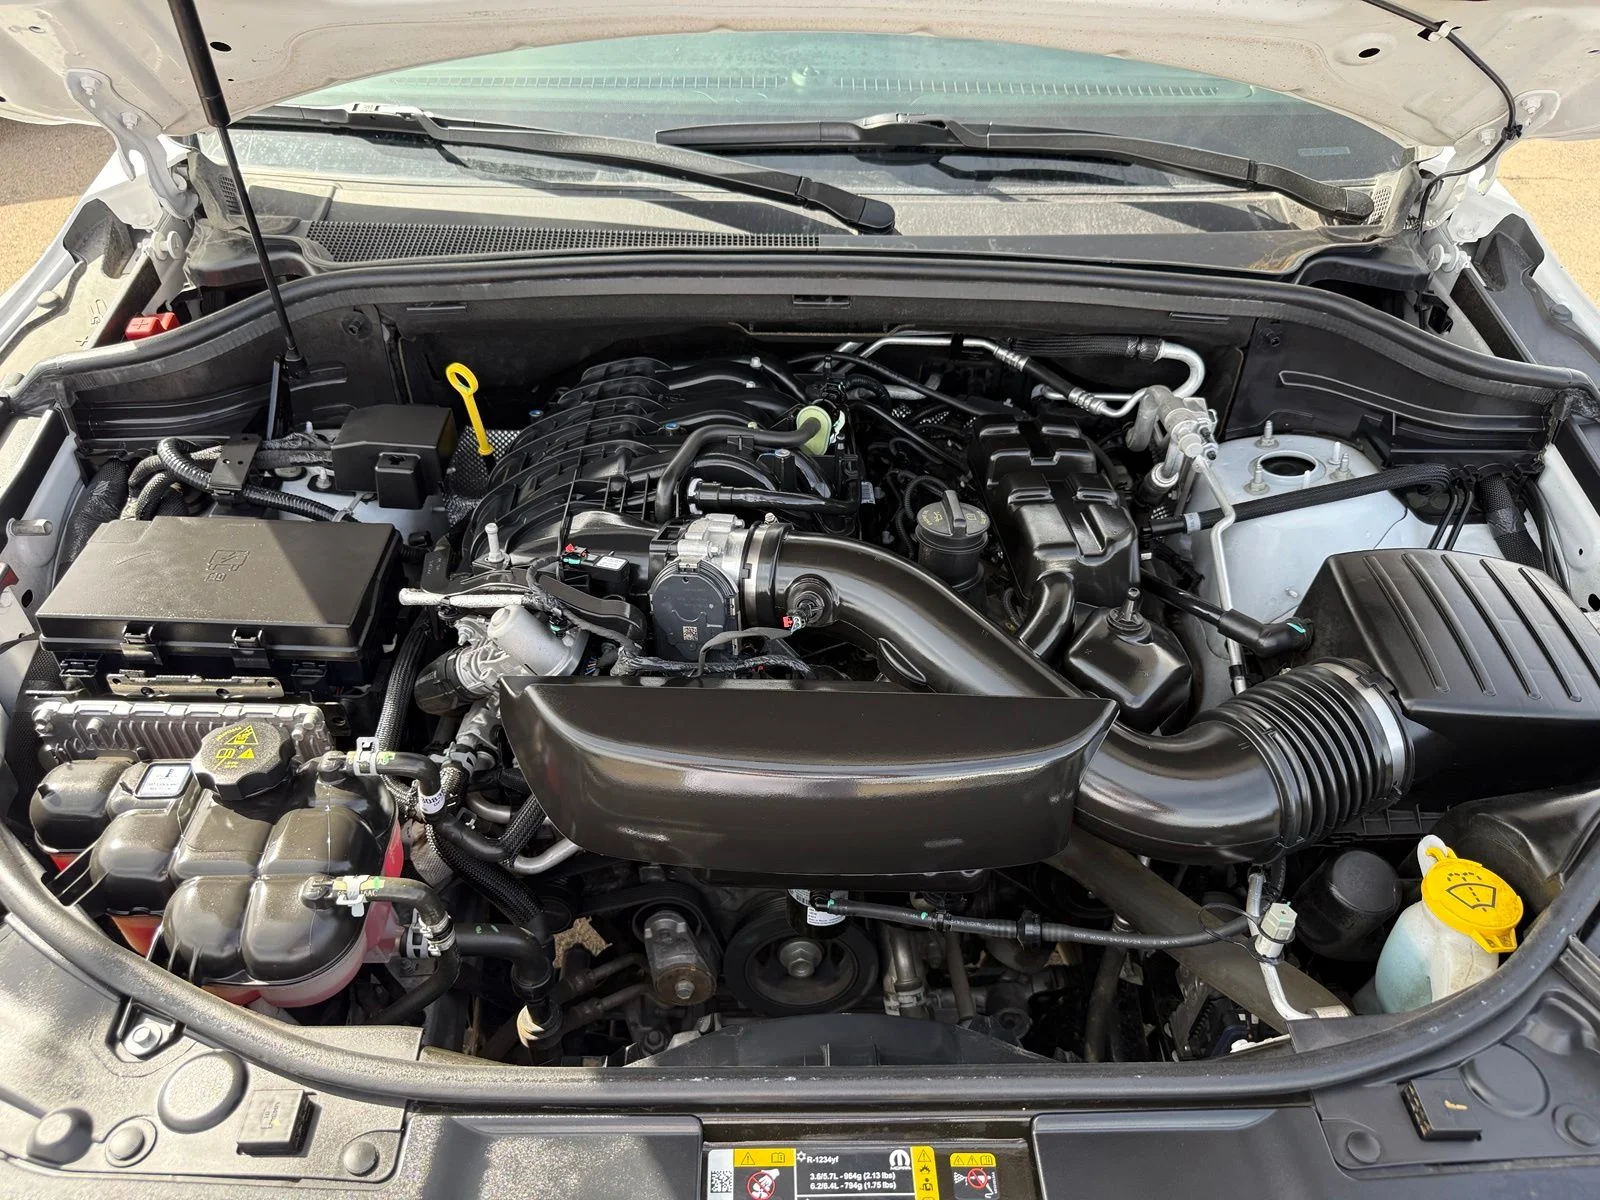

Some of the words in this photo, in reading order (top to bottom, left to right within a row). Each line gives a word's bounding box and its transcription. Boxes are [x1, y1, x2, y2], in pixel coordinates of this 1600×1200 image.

[806, 1155, 839, 1165] R-1234yf
[810, 1172, 839, 1181] 3.6/5.7L
[863, 1171, 881, 1180] (2.13
[881, 1171, 896, 1180] lbs)
[810, 1182, 839, 1190] 6.2/6.4L
[844, 1182, 863, 1190] 794g
[863, 1181, 881, 1190] (1.75
[882, 1181, 897, 1190] lbs)
